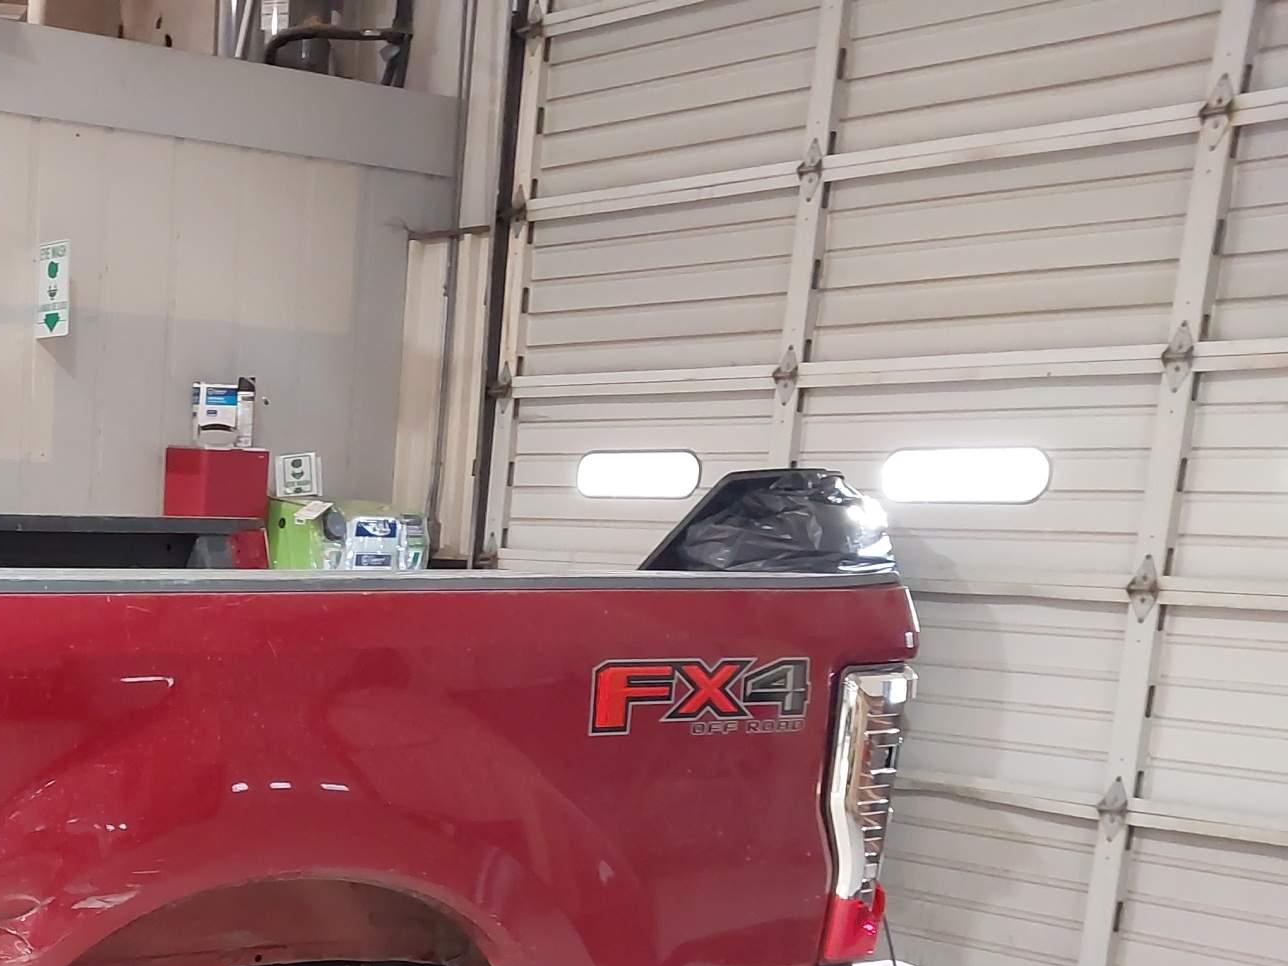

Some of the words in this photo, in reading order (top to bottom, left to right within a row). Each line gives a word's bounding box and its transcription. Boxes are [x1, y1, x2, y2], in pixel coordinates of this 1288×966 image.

[588, 657, 810, 736] FX4
[690, 720, 738, 735] OFF
[746, 718, 804, 734] ROAD
